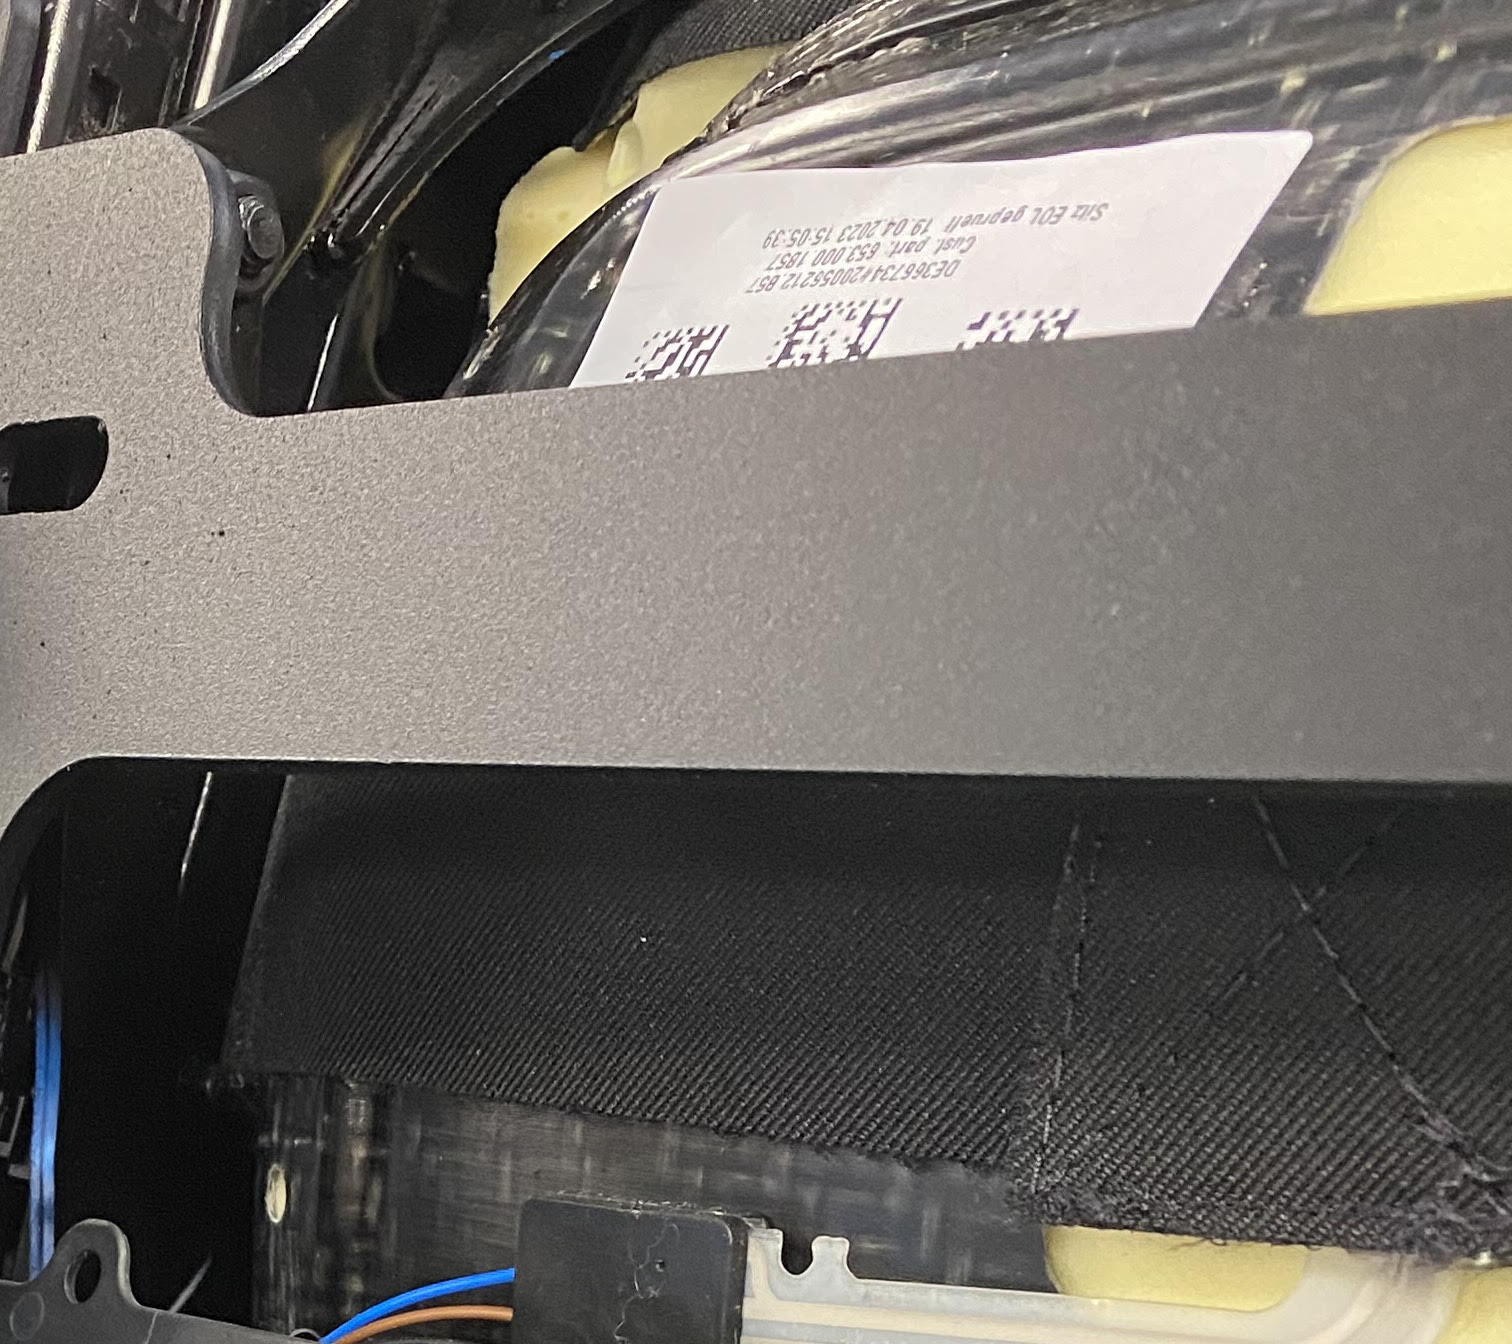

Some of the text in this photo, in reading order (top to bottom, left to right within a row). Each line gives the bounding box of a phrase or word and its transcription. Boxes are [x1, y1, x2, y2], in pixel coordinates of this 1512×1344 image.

[762, 203, 1109, 249] Sitz EOL geprueft 19.04.2023 15:05:39
[934, 235, 977, 255] Cust.
